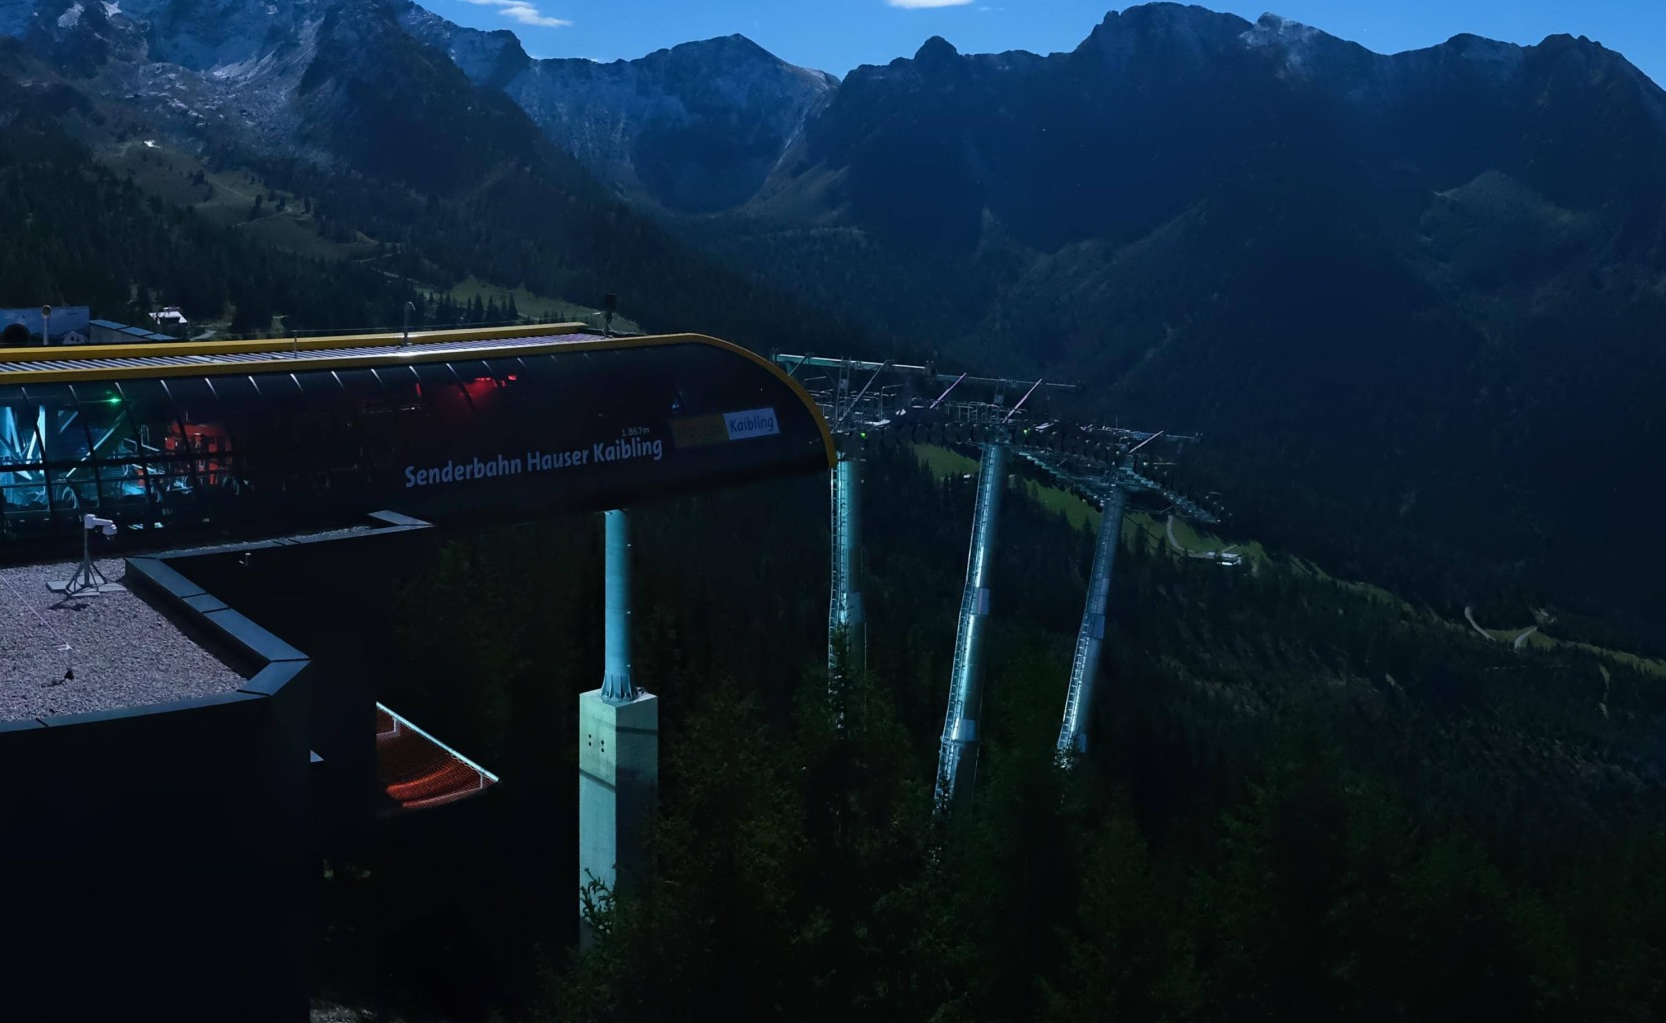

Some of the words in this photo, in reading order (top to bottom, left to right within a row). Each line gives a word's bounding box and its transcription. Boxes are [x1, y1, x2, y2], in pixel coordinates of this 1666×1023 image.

[729, 416, 774, 433] Kaibling
[404, 454, 522, 488] Senderbahn
[527, 449, 589, 473] Hauser
[593, 437, 663, 462] Kaibling
